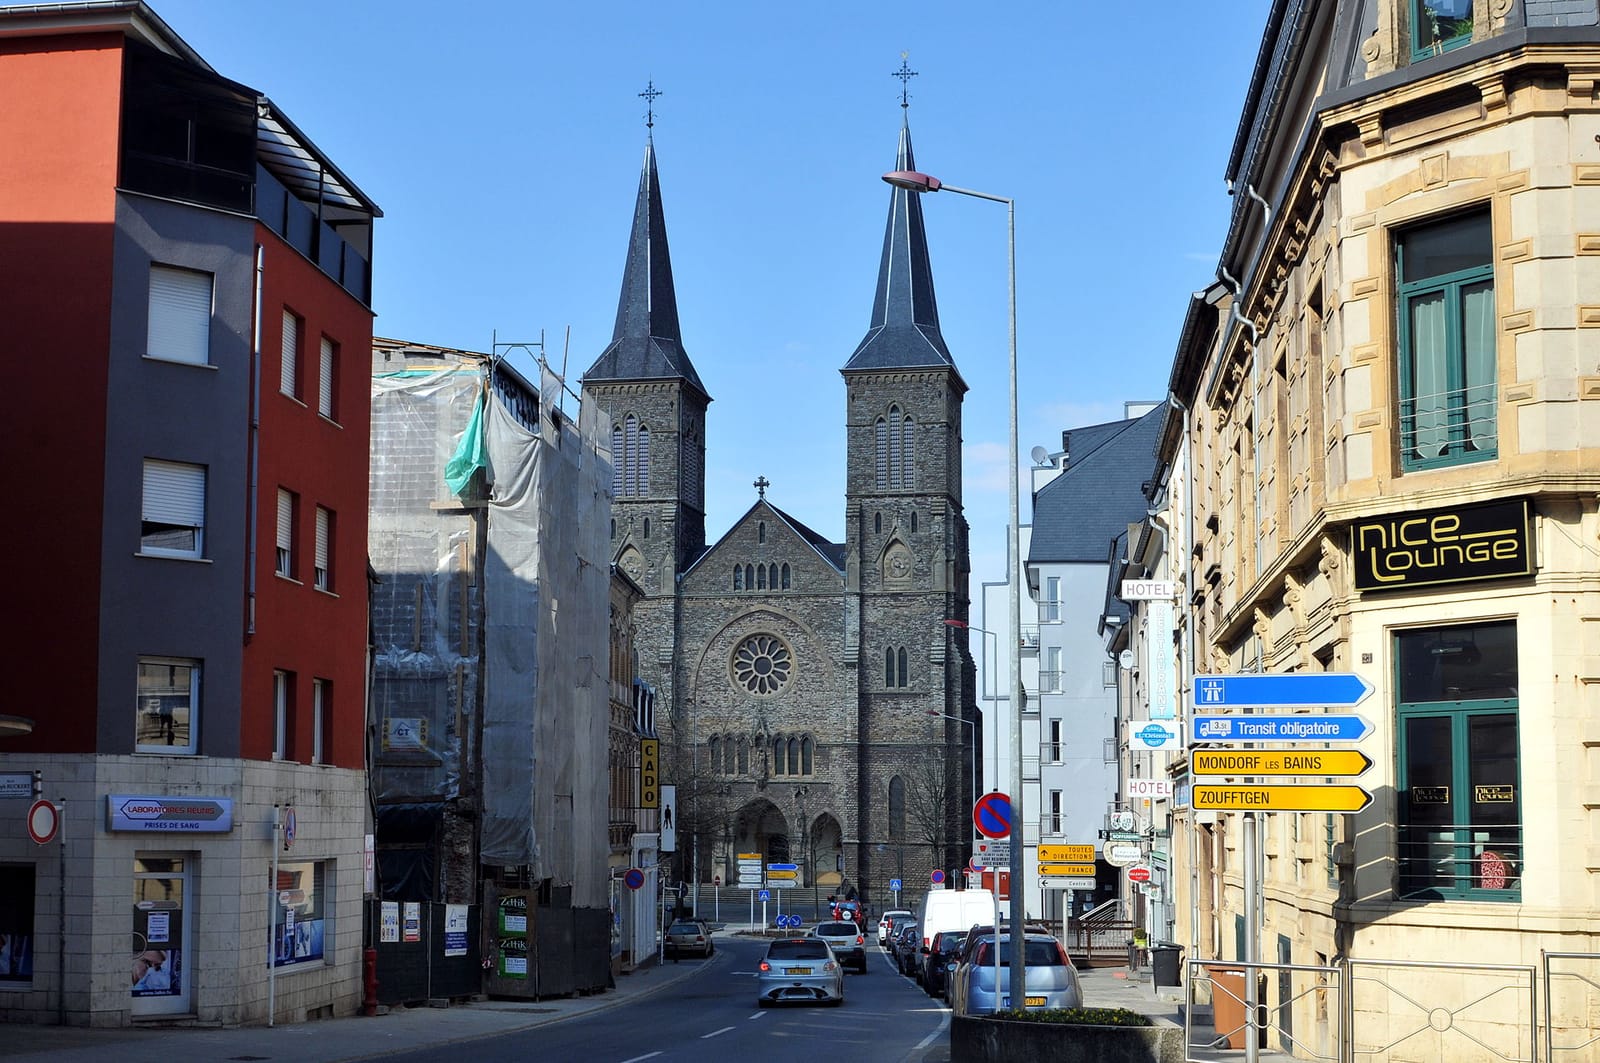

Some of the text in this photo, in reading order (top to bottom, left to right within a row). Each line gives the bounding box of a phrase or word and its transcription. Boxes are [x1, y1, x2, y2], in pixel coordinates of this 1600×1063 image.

[1127, 584, 1170, 595] HOTEL
[1156, 606, 1167, 717] RESTAURANT
[1238, 722, 1276, 735] Transit
[1280, 721, 1340, 737] obligatoire
[1200, 757, 1321, 769] MONDORF LES BAINS
[645, 745, 655, 802] CADO
[1130, 782, 1171, 794] HOTEL
[1200, 791, 1270, 804] ZOUFFTGEN
[128, 806, 184, 814] LABORATOIRES
